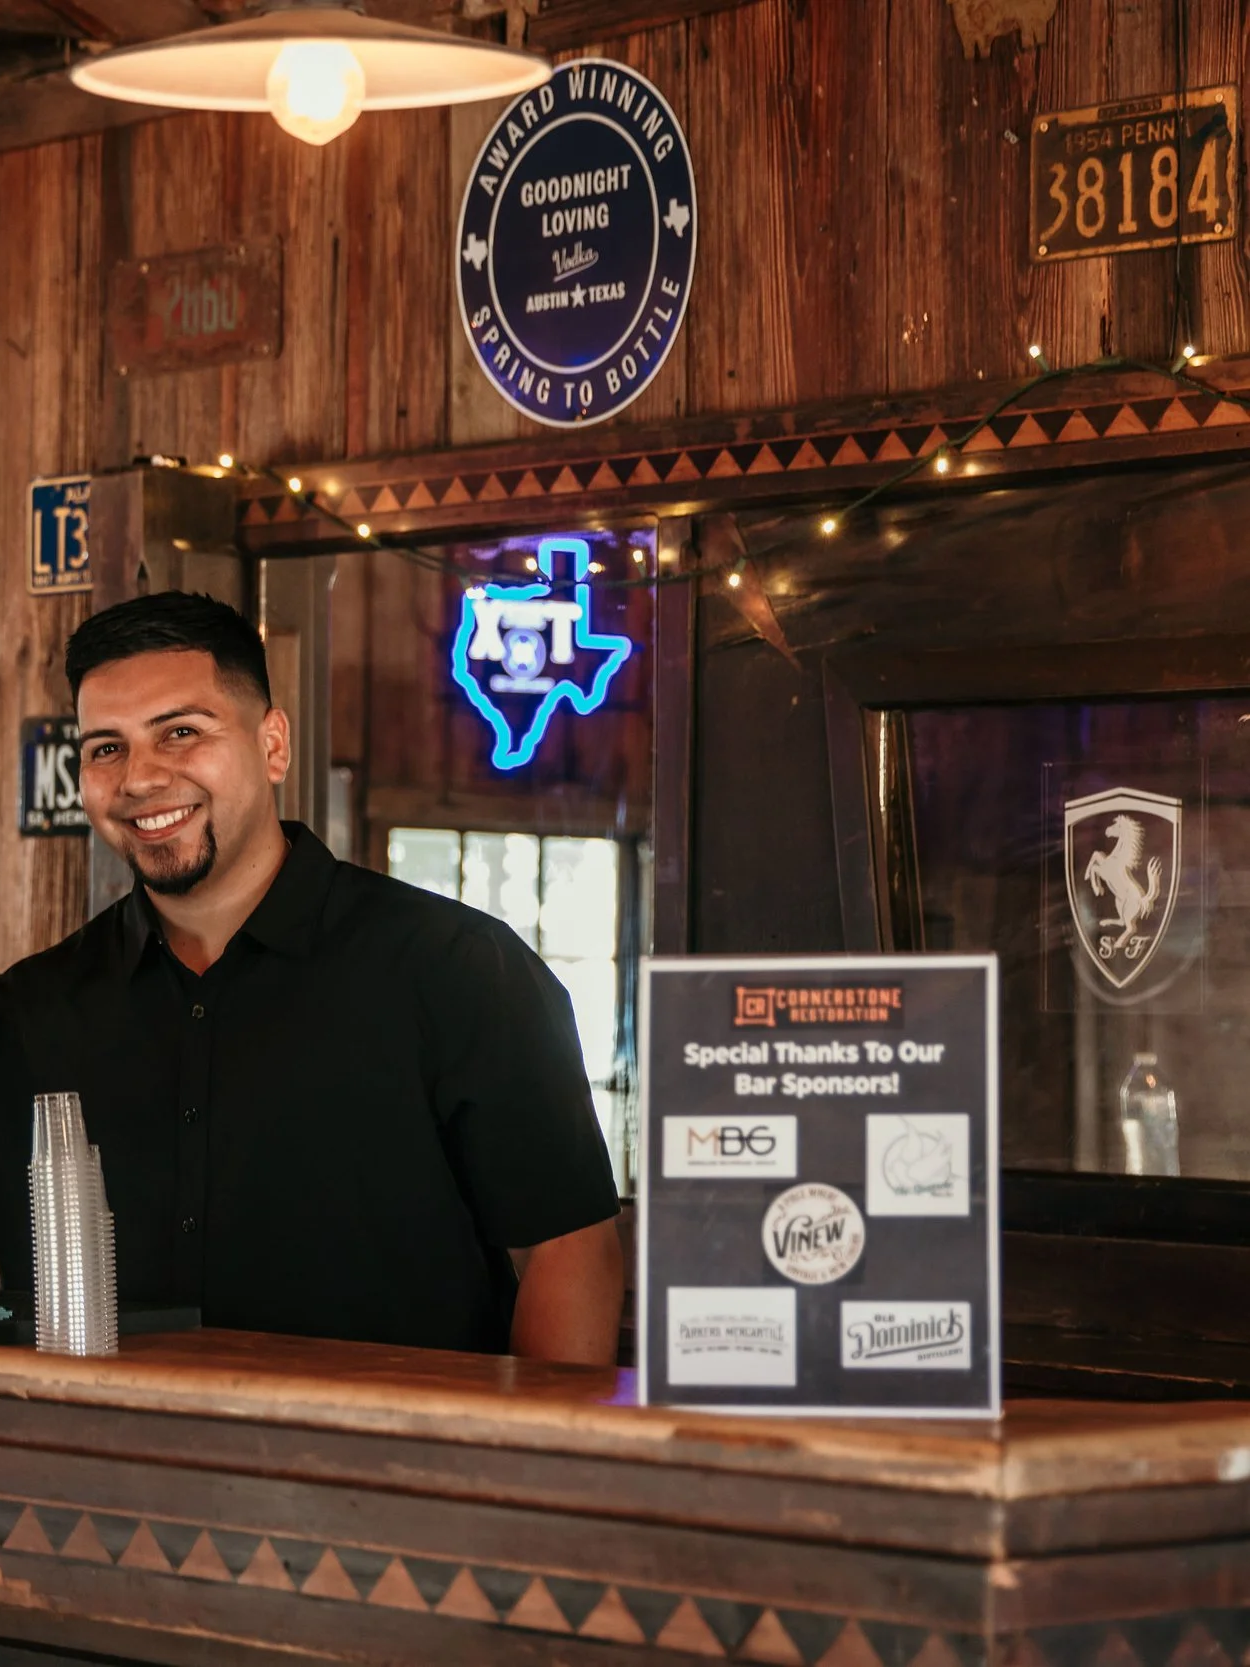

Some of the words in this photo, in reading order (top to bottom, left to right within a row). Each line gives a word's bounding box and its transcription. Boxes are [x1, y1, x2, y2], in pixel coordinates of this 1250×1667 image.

[478, 84, 554, 197] AWARD
[568, 69, 674, 163] WINNING
[1065, 128, 1113, 155] 1954
[520, 163, 631, 208] GOODNIGHT
[1039, 138, 1220, 243] 38184
[541, 202, 610, 238] LOVING
[552, 240, 598, 277] Vodka
[525, 290, 569, 314] AUSTIN
[589, 281, 626, 304] TEXAS
[473, 304, 551, 405] SPRING
[563, 380, 594, 409] TO
[605, 277, 680, 395] BOTTLE
[1100, 935, 1113, 959] S
[776, 987, 902, 1009] CORNERSTONE
[790, 1006, 889, 1023] RESTORATION
[683, 1042, 769, 1068] Special
[772, 1041, 859, 1064] Thanks
[863, 1041, 893, 1063] To
[897, 1040, 945, 1063] Our
[734, 1073, 777, 1095] Bar
[781, 1072, 900, 1099] Sponsors!
[687, 1125, 776, 1156] MBG
[847, 1308, 964, 1360] Dominick
